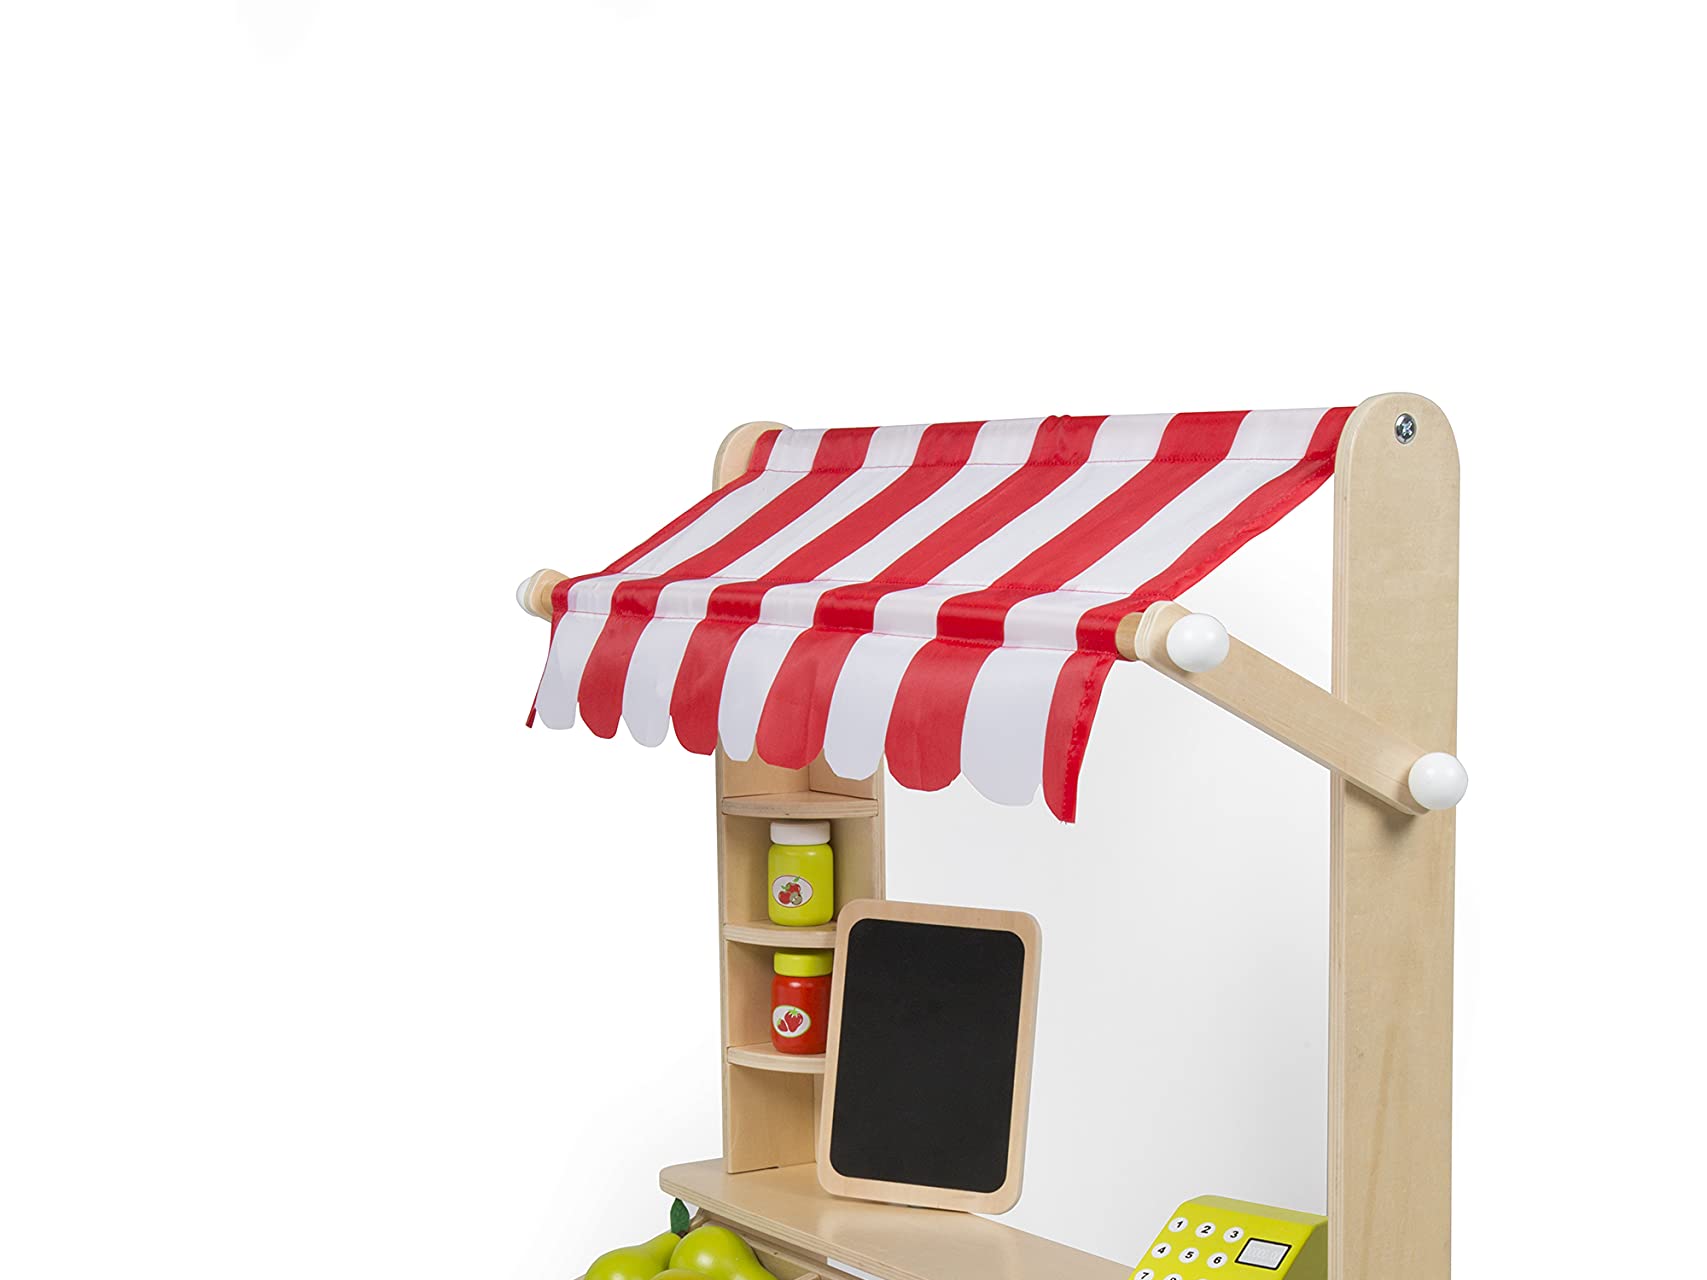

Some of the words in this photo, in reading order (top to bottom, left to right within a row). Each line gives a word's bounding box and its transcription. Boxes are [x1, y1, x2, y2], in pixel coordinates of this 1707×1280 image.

[1175, 1220, 1184, 1229] 1
[1201, 1225, 1212, 1234] 2
[1229, 1230, 1239, 1239] 3
[1157, 1246, 1167, 1254] 4
[1184, 1251, 1194, 1259] 5
[1213, 1256, 1223, 1265] 6
[1140, 1271, 1150, 1280] 7
